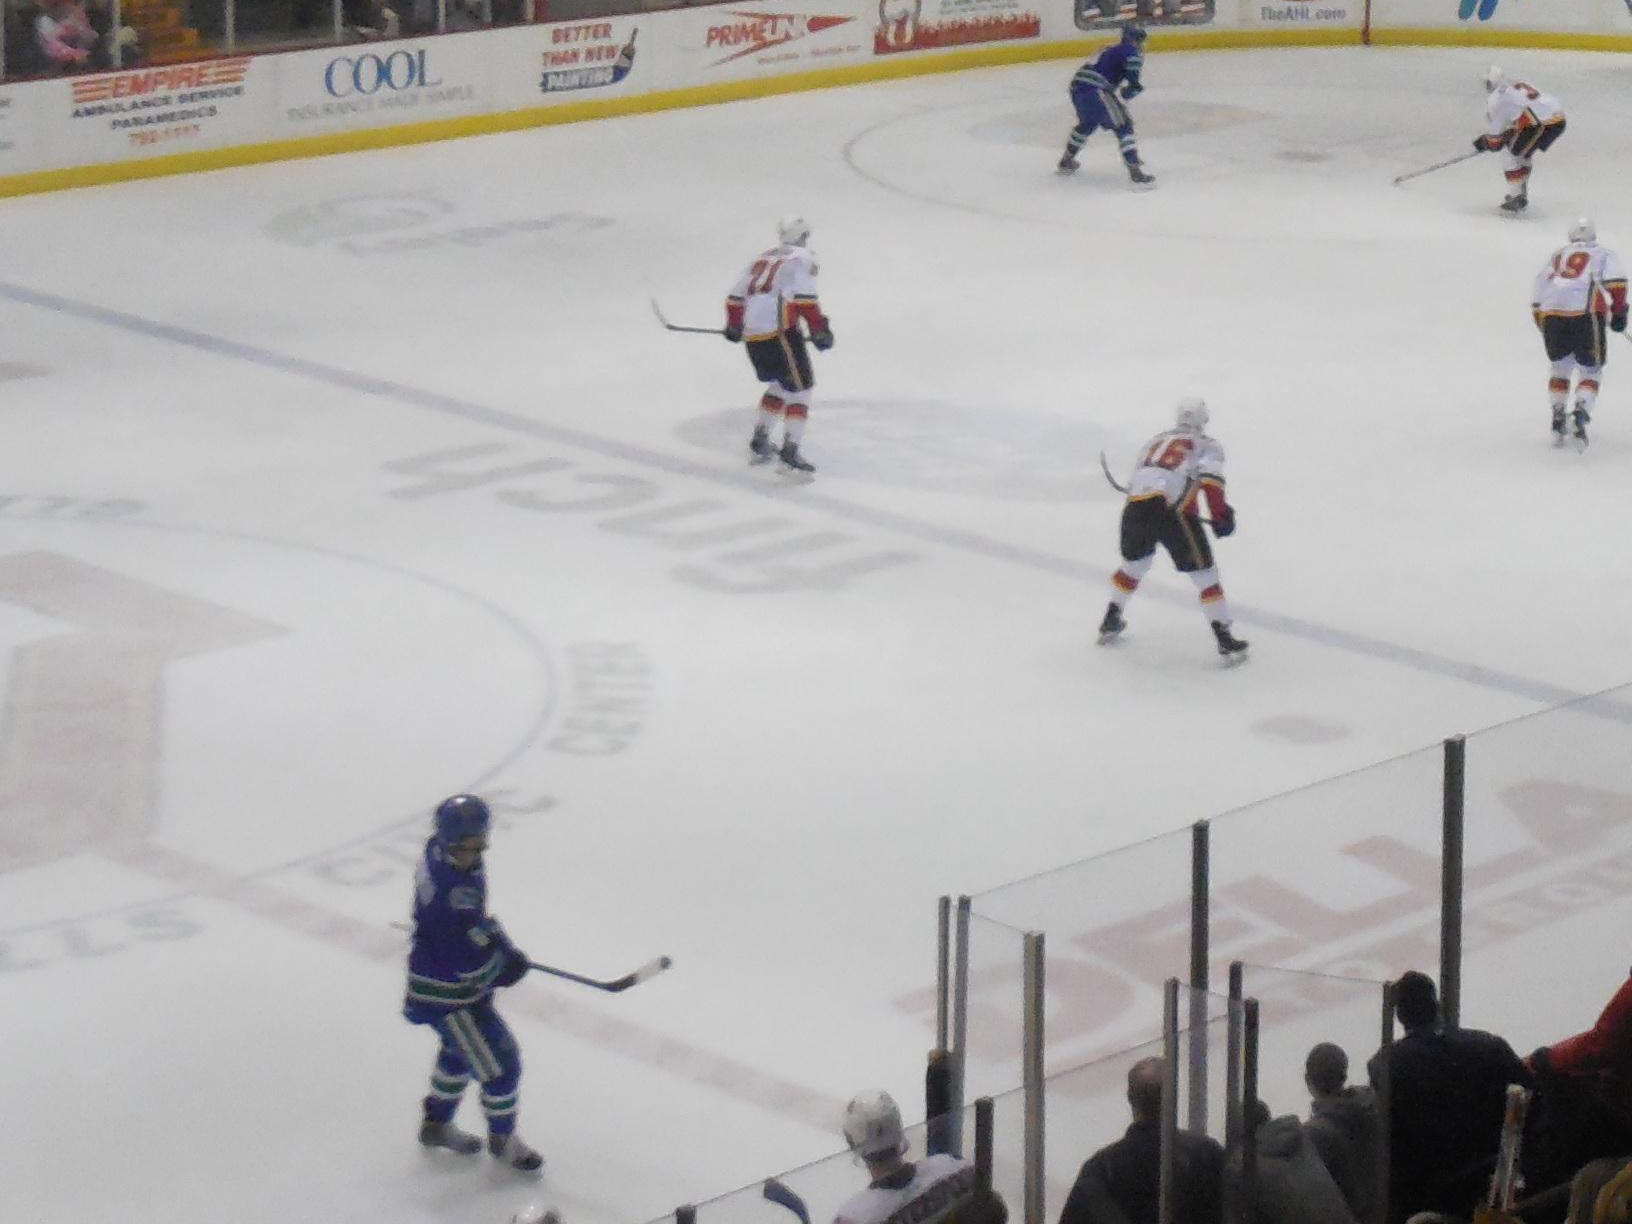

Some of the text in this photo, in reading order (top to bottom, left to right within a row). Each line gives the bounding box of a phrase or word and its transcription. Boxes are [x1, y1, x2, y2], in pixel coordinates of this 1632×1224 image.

[1260, 6, 1346, 21] TheAHL.com
[552, 23, 612, 45] BETTER
[543, 45, 620, 67] THAN NEW
[111, 64, 212, 99] EMPIRE
[325, 49, 443, 98] COOL
[71, 85, 245, 119] AMBULANCE SERVICE
[424, 84, 475, 103] SIMPLE
[111, 105, 218, 130] PARAMEDICS
